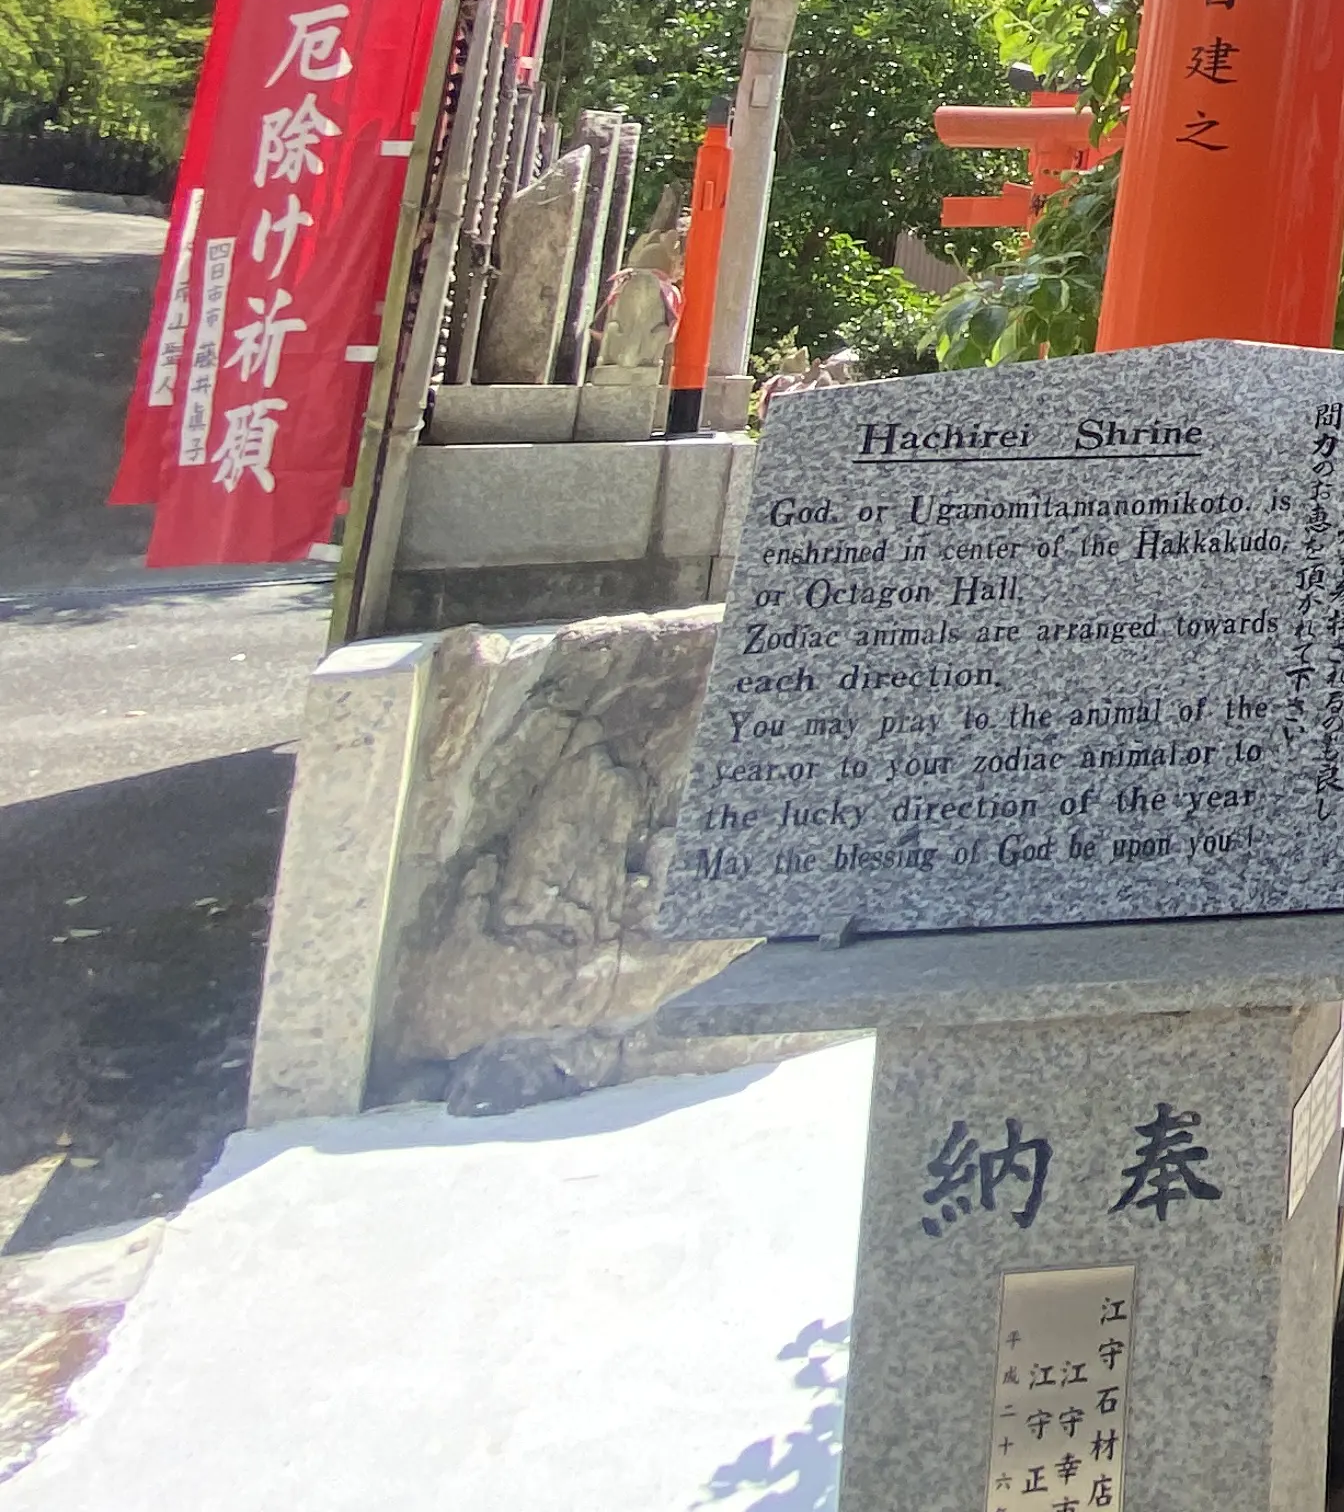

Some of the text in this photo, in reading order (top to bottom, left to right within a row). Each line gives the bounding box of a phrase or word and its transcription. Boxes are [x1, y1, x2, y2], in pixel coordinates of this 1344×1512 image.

[210, 4, 353, 494] 厄除け祈願
[858, 418, 1204, 457] Hachirei Shrine
[858, 505, 888, 523] or
[1270, 493, 1292, 514] is
[762, 537, 887, 566] enshrined
[905, 539, 926, 563] in
[943, 541, 1021, 561] center
[1036, 532, 1065, 560] of
[1080, 530, 1120, 558] the
[754, 589, 785, 609] or
[805, 578, 931, 610] Octagon
[742, 611, 1280, 655] Zodiac animals are arranged towards
[735, 667, 814, 694] each
[728, 710, 785, 743] You
[804, 716, 860, 742] may
[879, 712, 941, 740] pray
[1008, 703, 1057, 730] the
[1068, 698, 1160, 727] animal
[1178, 696, 1207, 723] of
[1224, 694, 1269, 720] the
[840, 756, 868, 781] to
[885, 756, 952, 783] your
[972, 743, 1065, 774] zodiac
[1234, 738, 1262, 763] to
[704, 803, 758, 831] the
[780, 798, 868, 830] lucky
[891, 794, 1037, 823] direction
[1059, 788, 1092, 818] of
[1115, 786, 1166, 814] the
[694, 848, 753, 883] May
[774, 845, 816, 874] the
[834, 841, 938, 872] blessing
[953, 836, 982, 866] of
[998, 832, 1057, 867] God
[1069, 831, 1097, 862] be
[1112, 830, 1171, 862] upon
[994, 1329, 1022, 1512] 平成二十六
[1087, 1296, 1128, 1508] 江守石材店
[1020, 1362, 1057, 1495] 江守正
